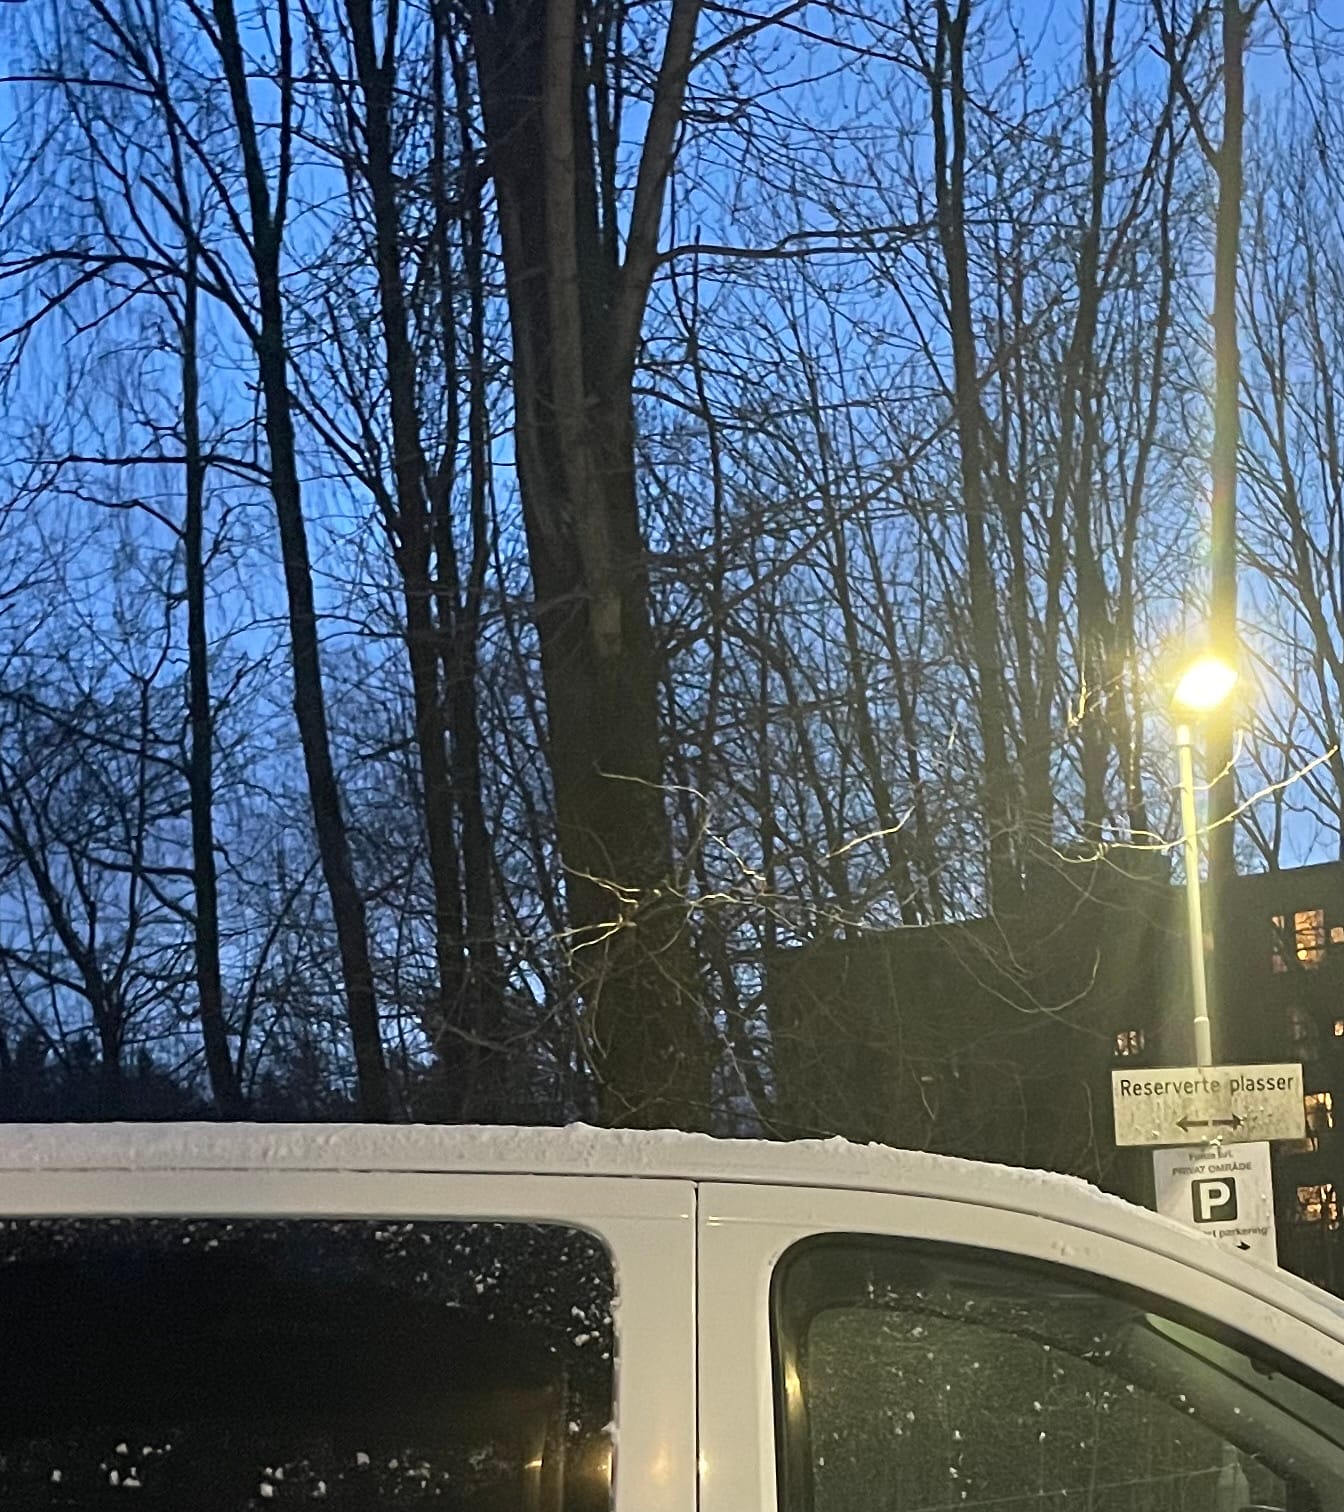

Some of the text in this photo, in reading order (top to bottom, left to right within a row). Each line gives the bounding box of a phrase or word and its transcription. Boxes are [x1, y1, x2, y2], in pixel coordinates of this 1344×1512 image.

[1120, 1075, 1294, 1096] Reserverte plasser
[1208, 1161, 1252, 1173] OMRÅDE
[1199, 1181, 1231, 1219] P
